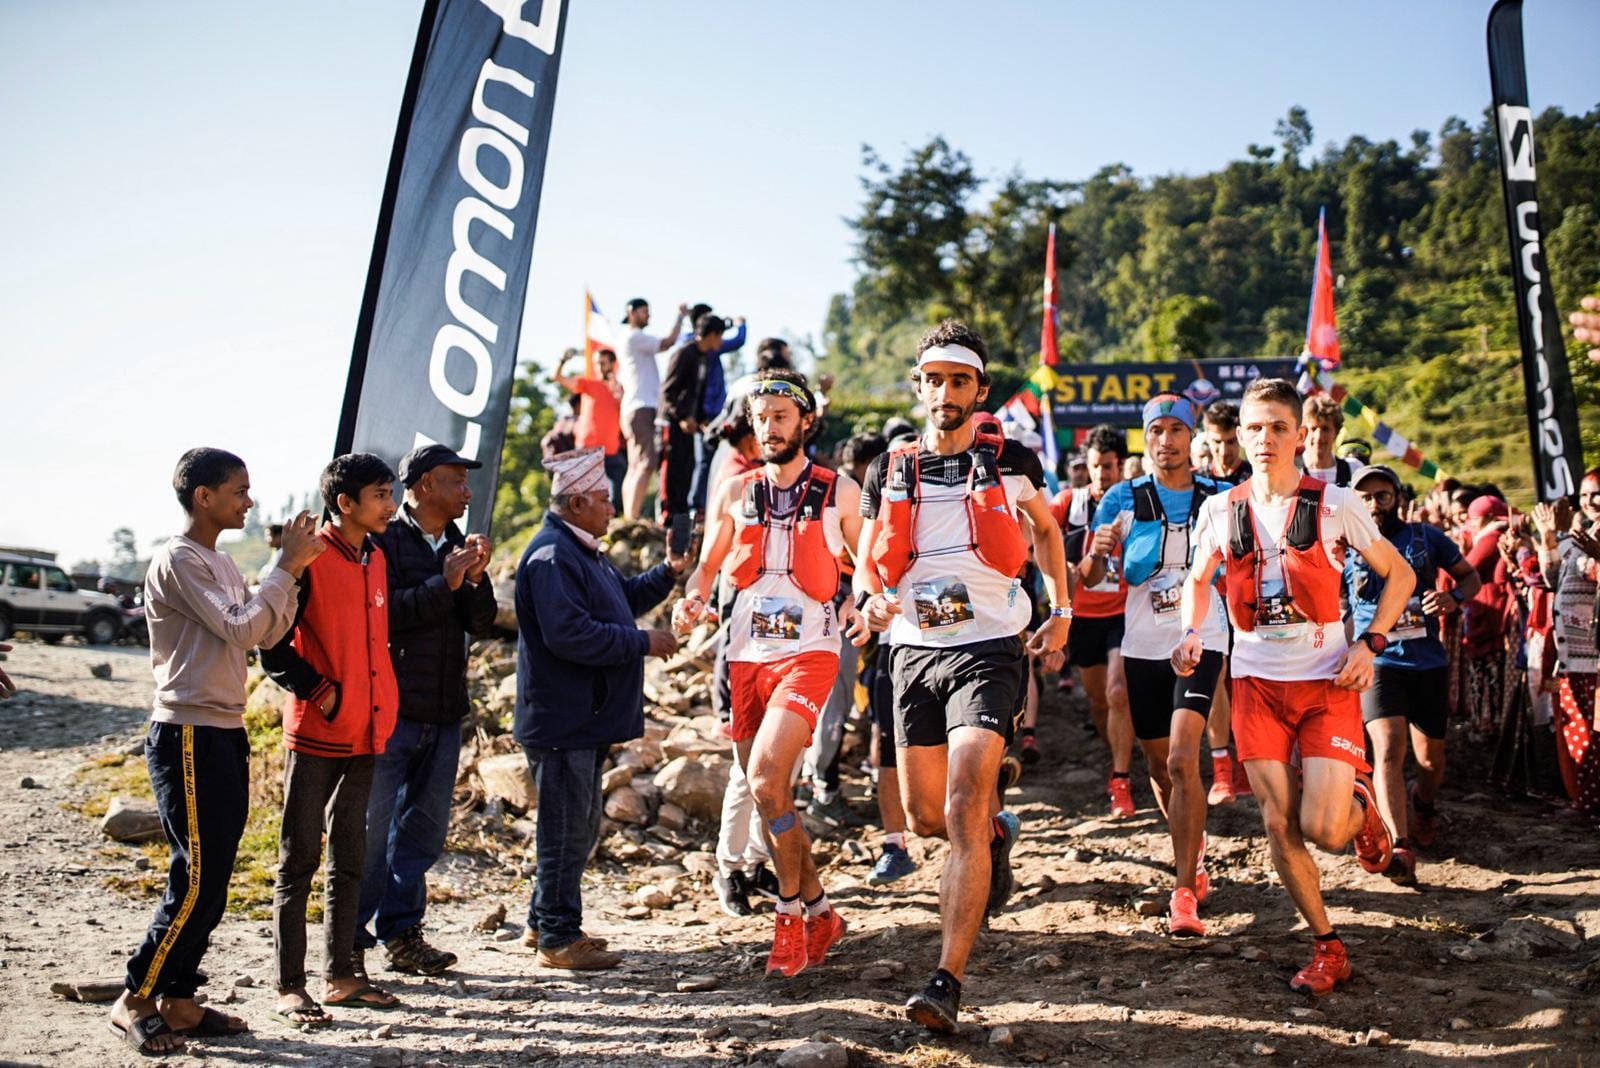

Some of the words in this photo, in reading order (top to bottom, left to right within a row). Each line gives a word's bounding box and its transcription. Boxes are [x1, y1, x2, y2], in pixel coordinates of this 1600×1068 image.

[413, 58, 536, 466] lomon
[1055, 373, 1177, 403] START
[184, 751, 194, 796] OFF-WHITE
[191, 840, 200, 886] OFF-WHITE
